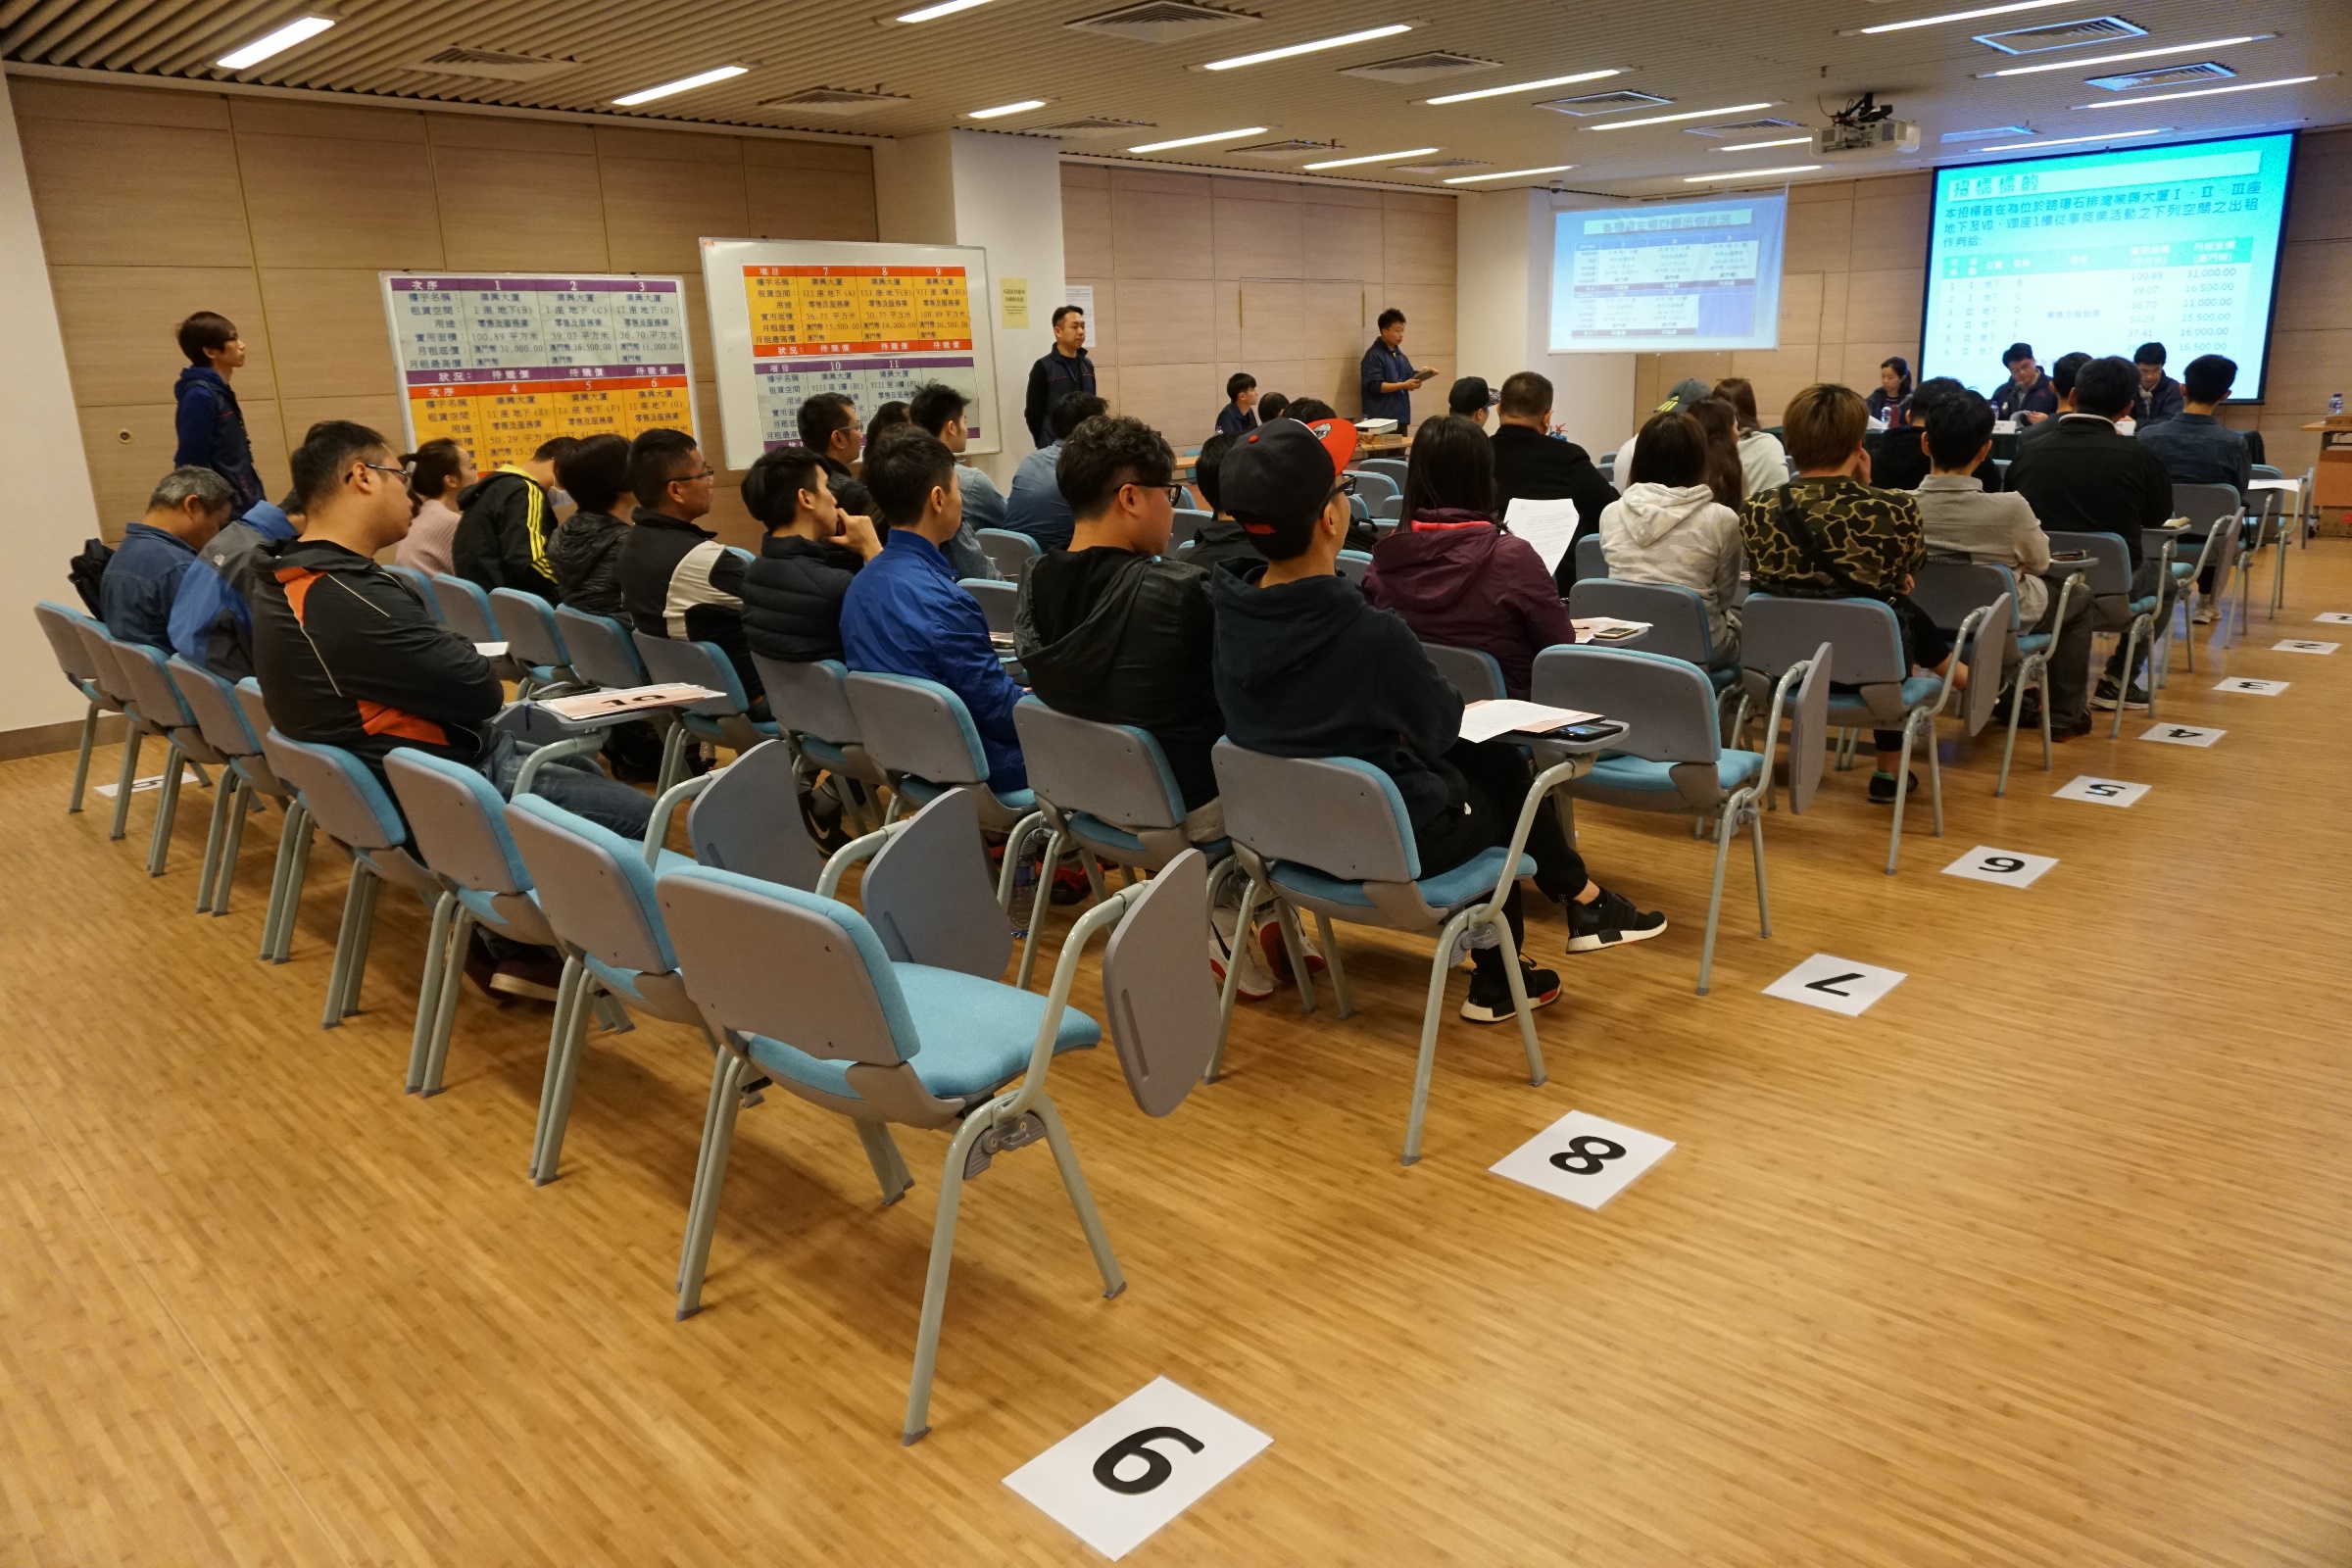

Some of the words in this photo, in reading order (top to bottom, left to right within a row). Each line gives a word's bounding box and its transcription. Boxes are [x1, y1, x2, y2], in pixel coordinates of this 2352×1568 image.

[2187, 269, 2236, 278] 31,000.00
[495, 281, 501, 290] 1
[570, 281, 577, 290] 2
[830, 362, 841, 370] 10
[511, 384, 517, 393] 4
[2237, 681, 2271, 691] 3
[2168, 728, 2204, 740] 4
[2084, 783, 2127, 798] 5
[1804, 972, 1864, 997] 7
[1548, 1135, 1627, 1176] 8
